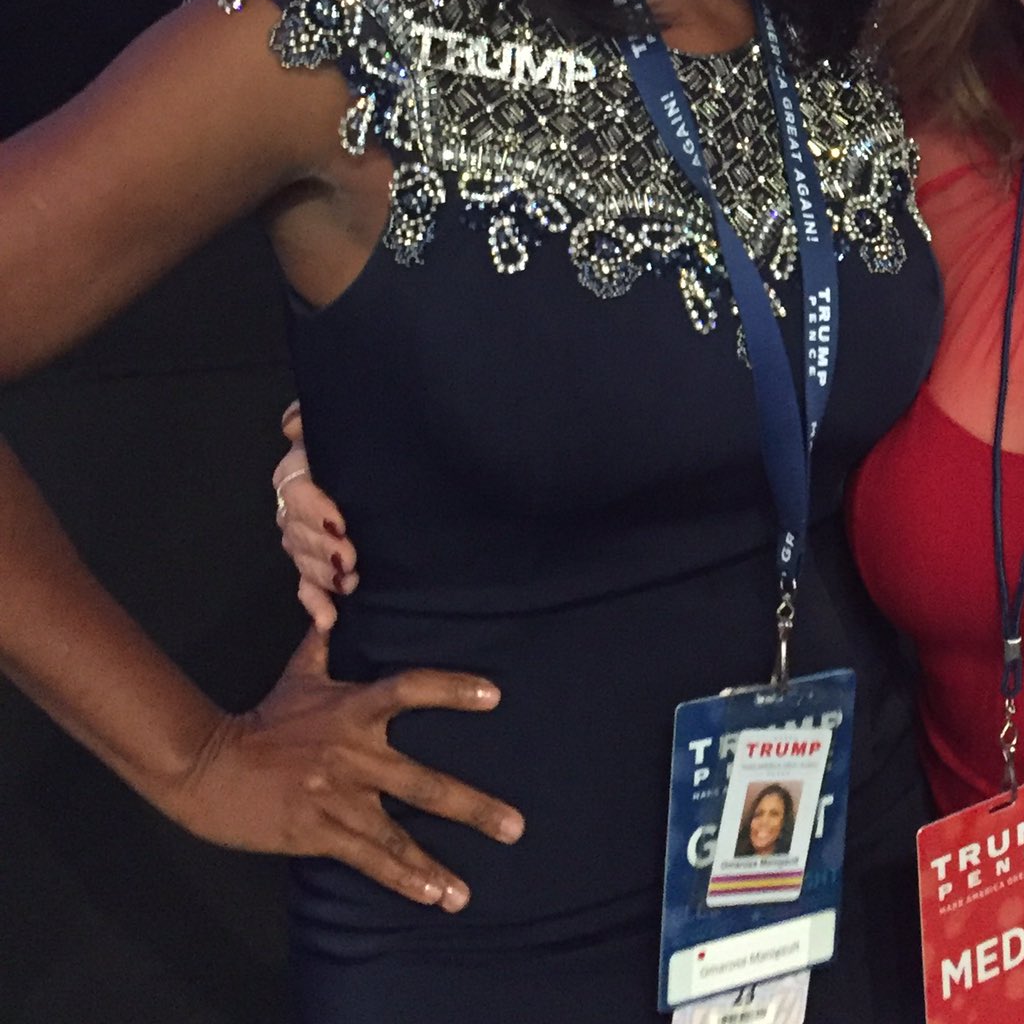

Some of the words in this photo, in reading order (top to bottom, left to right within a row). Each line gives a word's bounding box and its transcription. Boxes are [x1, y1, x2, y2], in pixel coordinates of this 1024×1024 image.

[409, 21, 597, 94] TRUMP
[660, 89, 702, 168] AGAIN!
[781, 96, 803, 164] GREAT
[793, 167, 820, 244] AGAIN!
[808, 294, 818, 377] PENCE
[817, 287, 832, 388] TRUMP
[747, 740, 822, 759] TRUMP
[966, 880, 1005, 904] AMERICA
